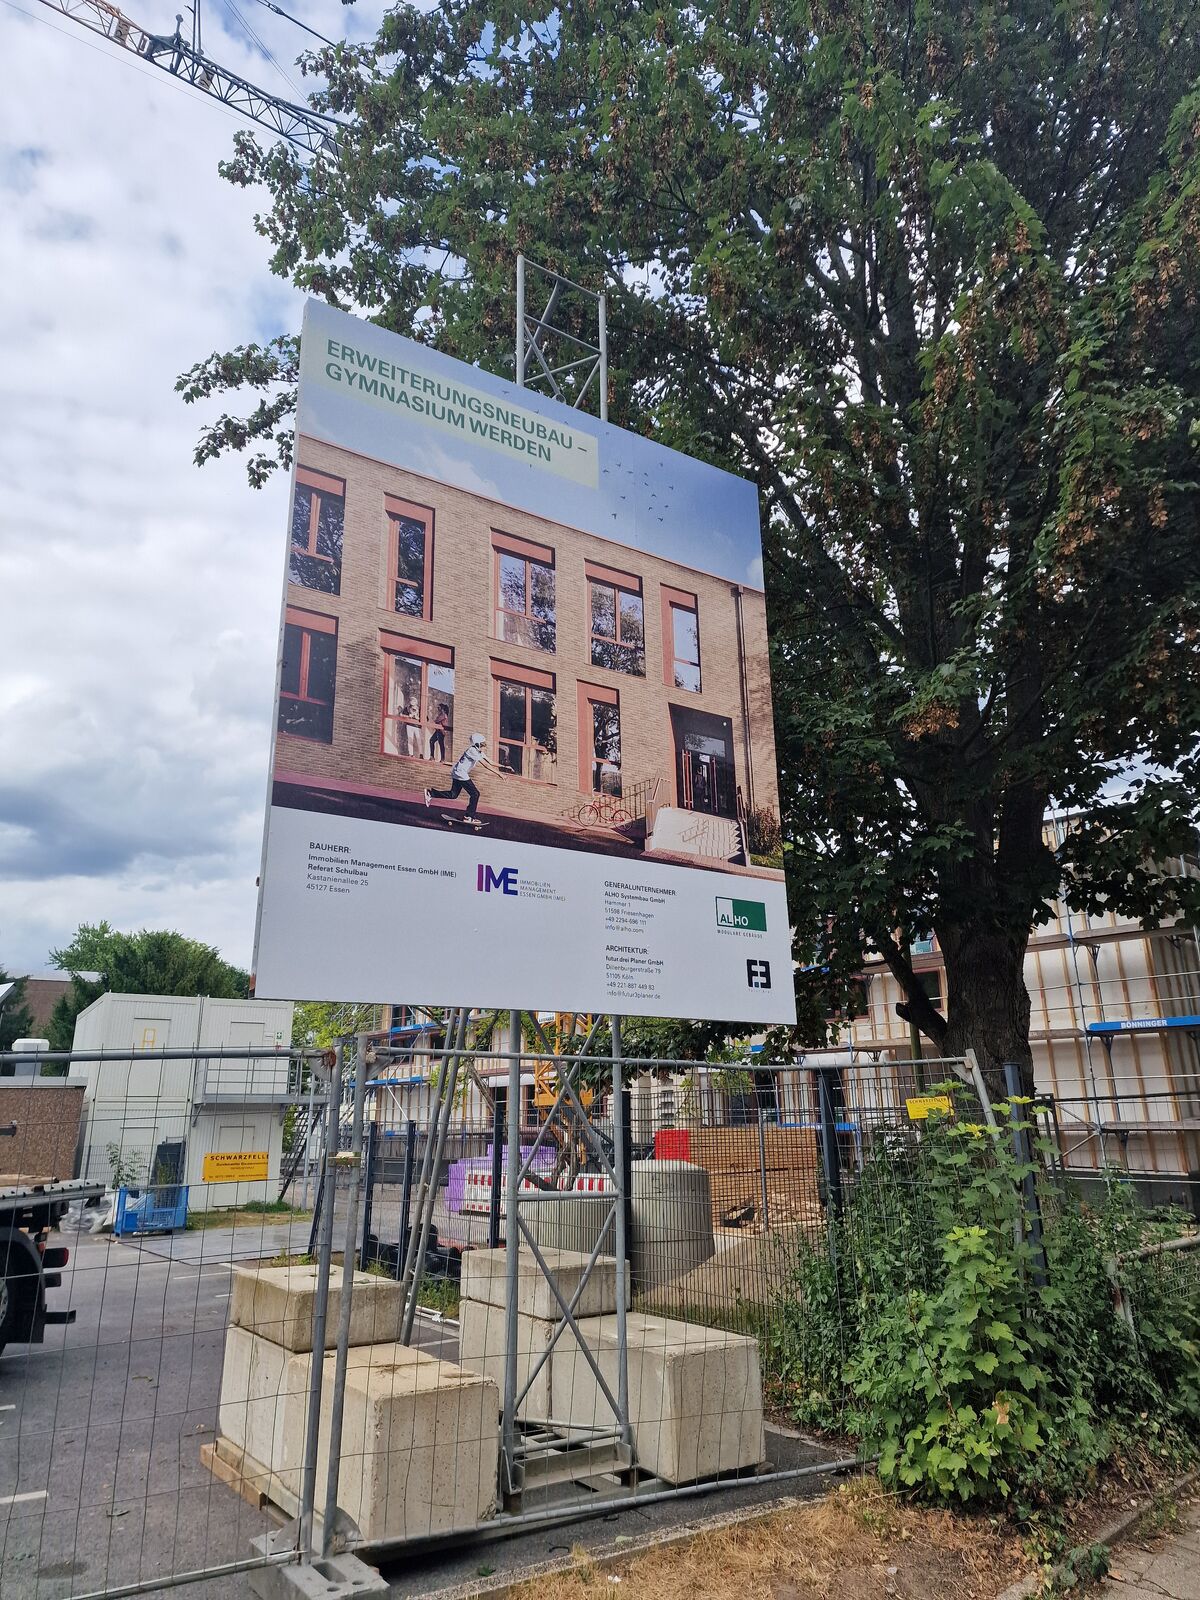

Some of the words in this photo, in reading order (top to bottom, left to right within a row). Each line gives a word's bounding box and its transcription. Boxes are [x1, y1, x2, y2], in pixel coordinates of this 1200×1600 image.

[328, 339, 573, 450] ERWEITERUNGSNEUBAU
[326, 362, 465, 428] GYMNASIUM
[469, 417, 551, 462] WERDEN
[309, 842, 352, 854] BAUHERR:
[308, 854, 349, 865] Immobilien
[350, 858, 396, 871] Management
[398, 864, 417, 874] Essen
[418, 868, 439, 876] GmbH
[440, 870, 457, 878] (IME)
[308, 864, 334, 873] Referat
[336, 866, 368, 877] Schulbau
[306, 872, 359, 885] Kastanienallee
[477, 863, 519, 896] IME
[520, 880, 551, 888] IMMOBILIEN
[306, 883, 328, 892] 45127
[329, 886, 350, 894] Essen
[520, 886, 556, 894] MANAGEMENT
[604, 890, 620, 898] ALHO
[620, 893, 649, 902] Systembau
